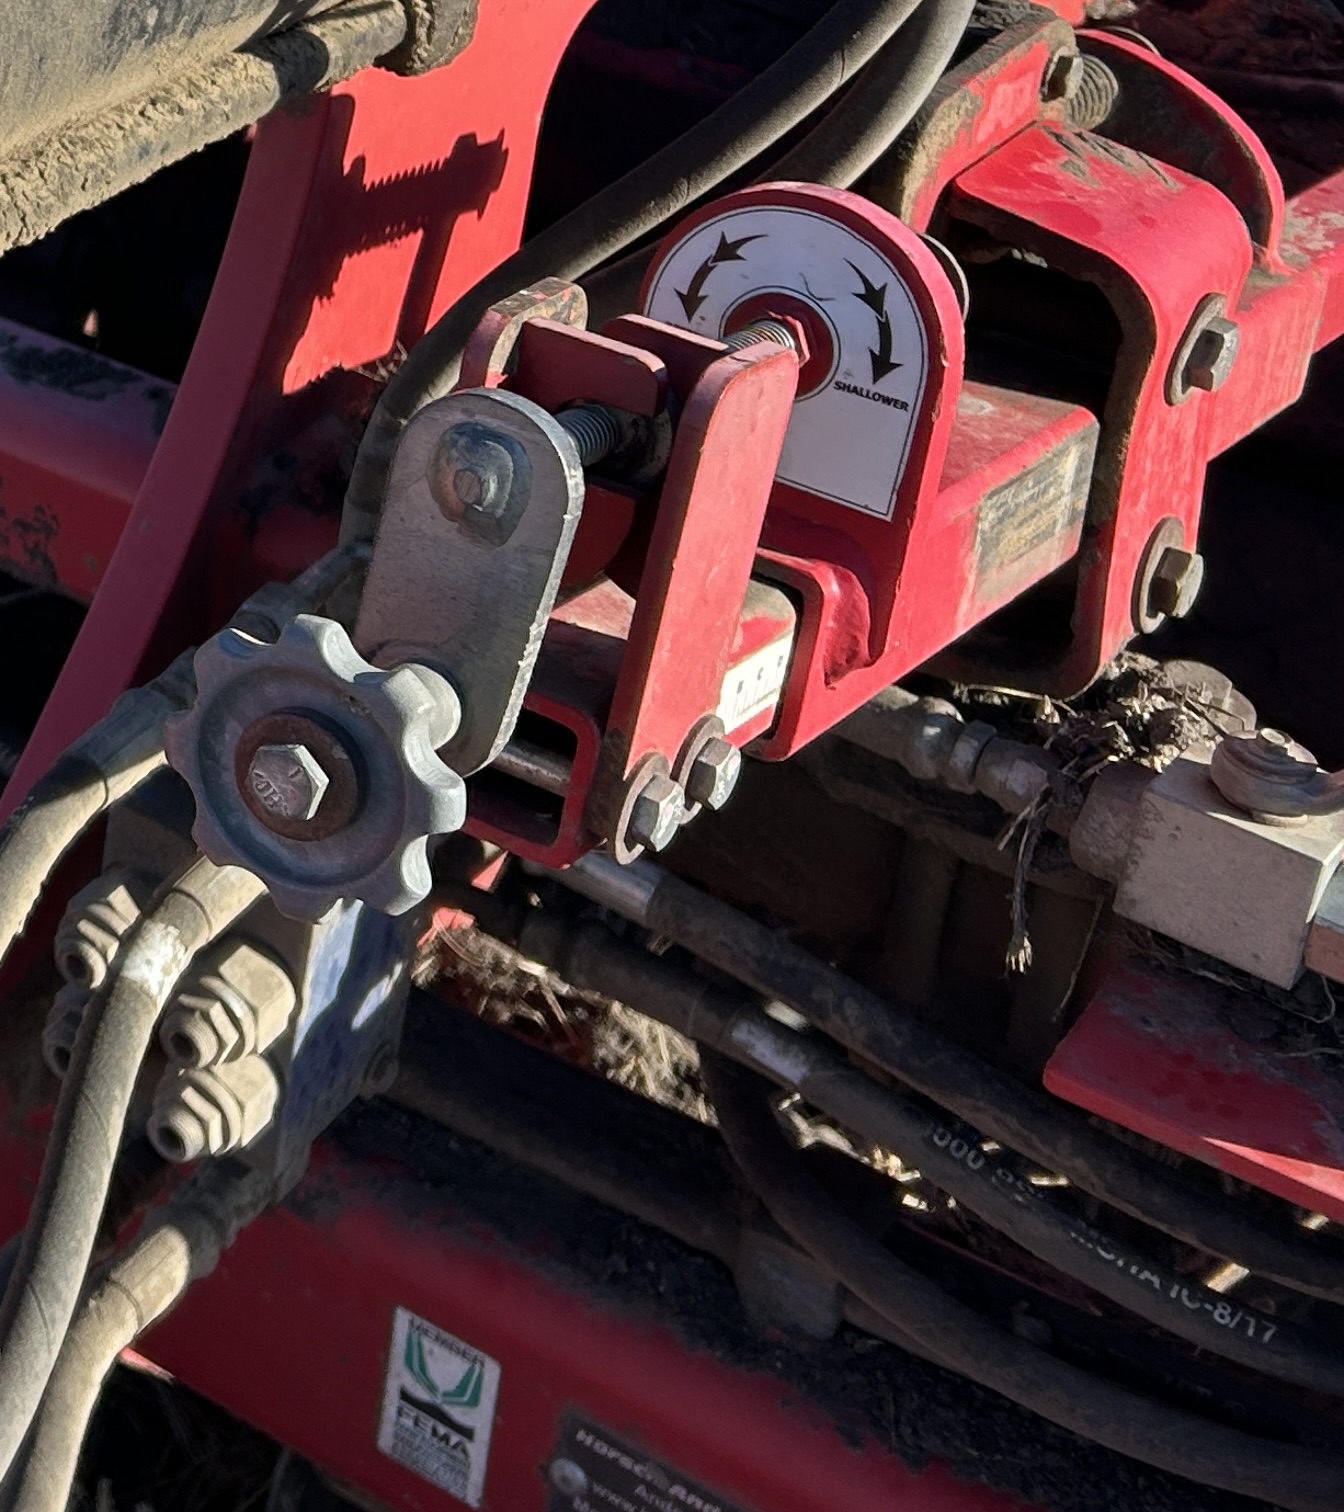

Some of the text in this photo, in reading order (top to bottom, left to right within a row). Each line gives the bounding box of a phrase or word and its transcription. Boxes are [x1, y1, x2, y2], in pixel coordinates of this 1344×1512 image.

[833, 380, 910, 413] SHALLOWER
[408, 1316, 486, 1369] MEMBER
[396, 1405, 470, 1456] FEMA
